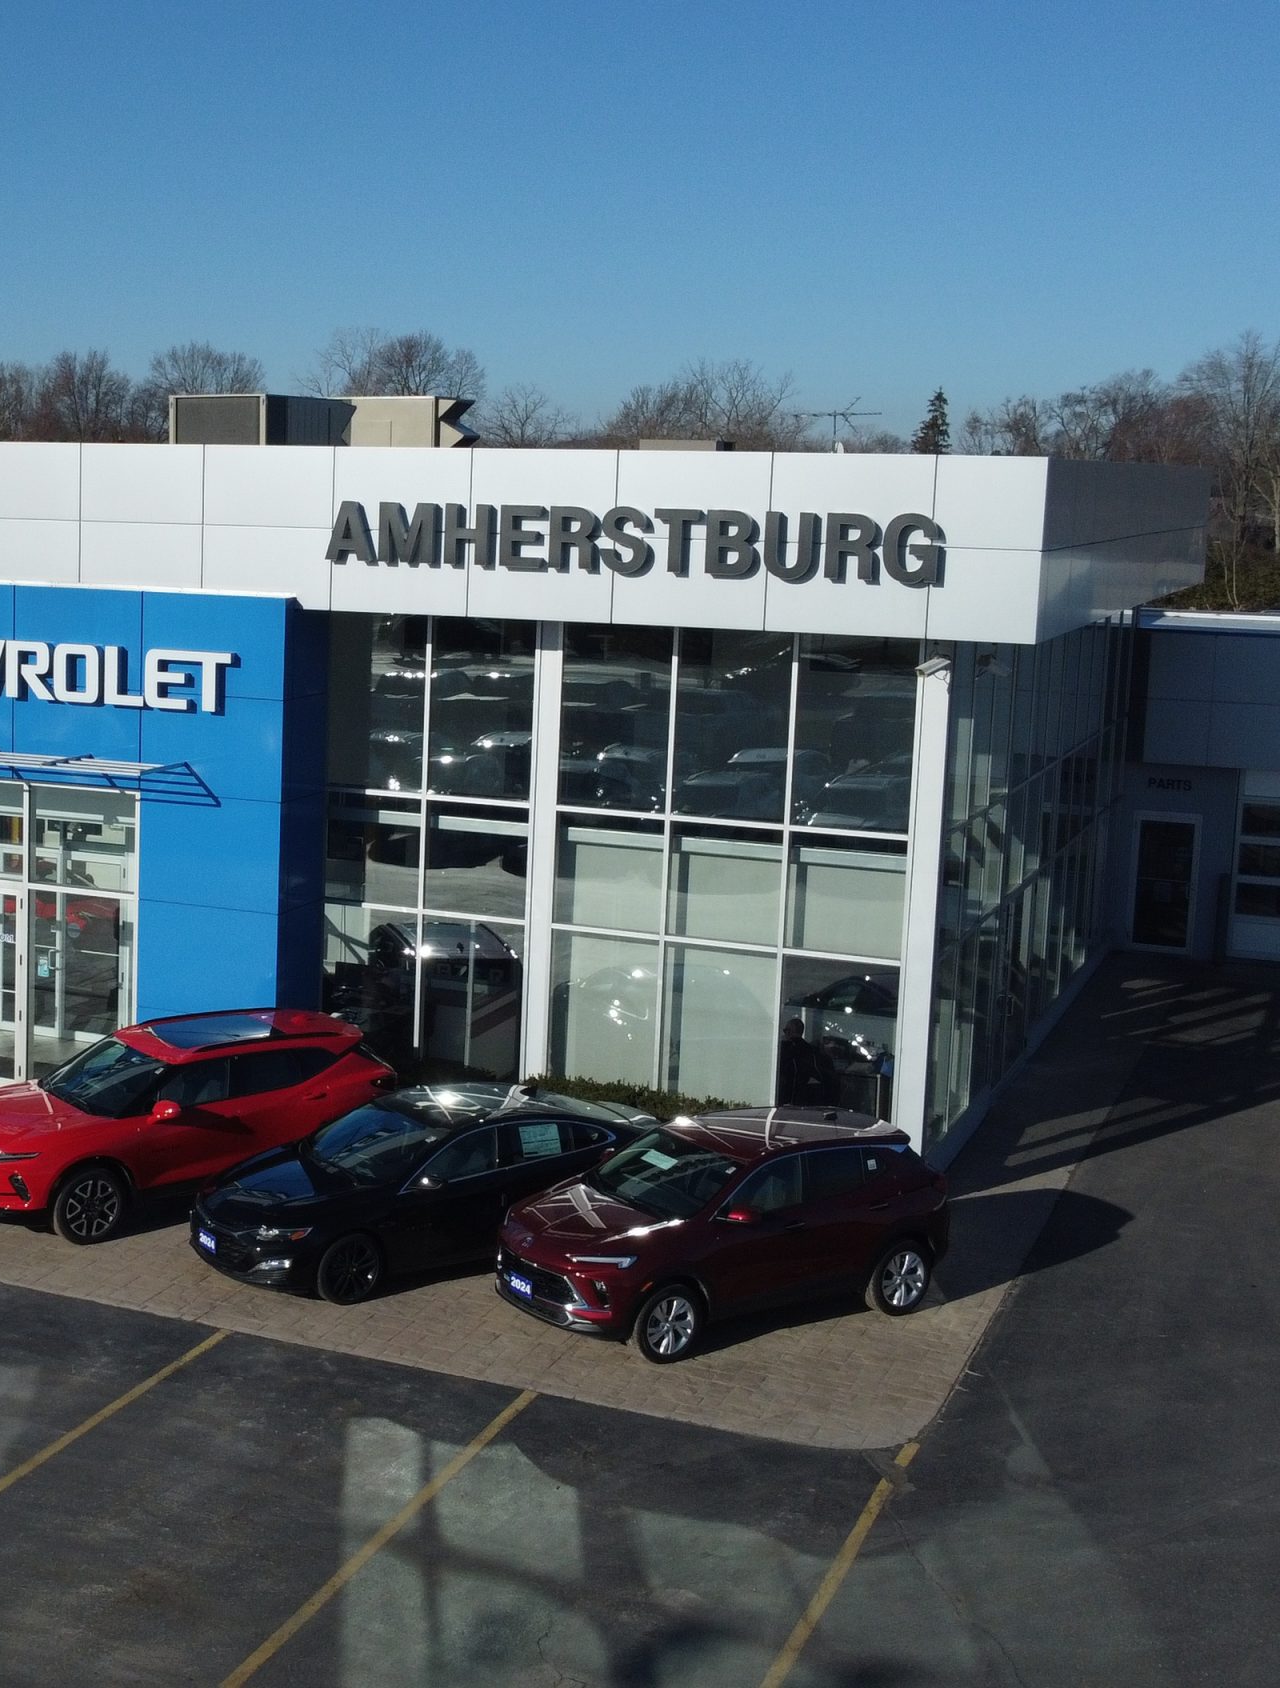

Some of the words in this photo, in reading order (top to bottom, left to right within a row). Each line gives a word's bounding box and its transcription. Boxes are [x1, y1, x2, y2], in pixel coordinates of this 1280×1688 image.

[324, 499, 947, 588] AMHERSTBURG
[1148, 777, 1193, 791] PARTS
[199, 1232, 215, 1251] 2024
[510, 1275, 531, 1295] 2024
